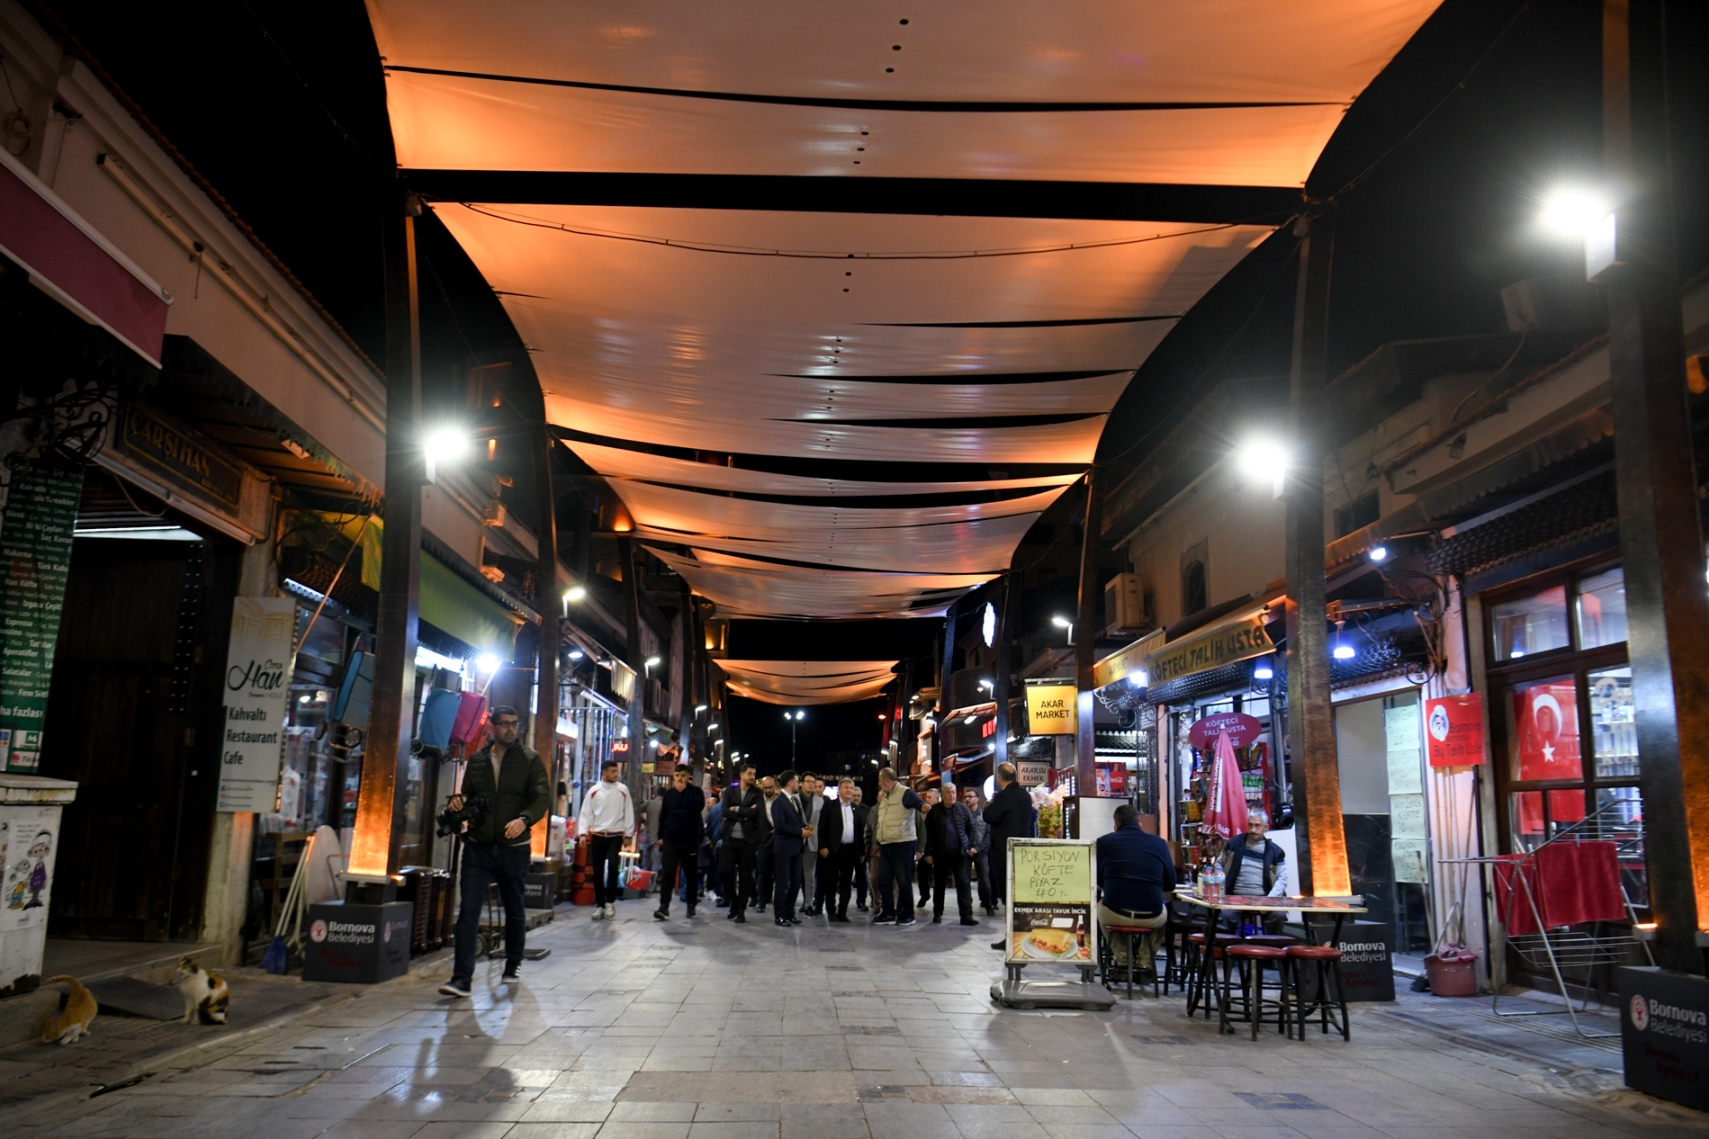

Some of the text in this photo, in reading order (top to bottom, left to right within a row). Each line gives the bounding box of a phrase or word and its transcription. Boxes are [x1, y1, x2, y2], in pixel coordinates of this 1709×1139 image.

[179, 443, 210, 478] HAN
[19, 483, 47, 493] Kahaltı
[26, 522, 42, 531] Biki
[5, 617, 34, 628] Espresso
[1150, 650, 1187, 683] KÖFTECİ
[1190, 639, 1223, 668] TALİH
[1228, 626, 1265, 655] USTA
[228, 660, 283, 691] Han
[0, 705, 11, 716] ha
[1041, 700, 1063, 709] AKAR
[229, 707, 267, 721] Kahvaltı
[1036, 710, 1070, 719] MARKET
[226, 729, 278, 743] Restaurant
[1203, 725, 1246, 737] TALİ USTA
[224, 751, 244, 765] Cafe
[1033, 863, 1075, 877] KÖFTE
[1030, 876, 1064, 889] PİYAZ
[1036, 888, 1057, 899] 40
[1071, 906, 1087, 915] İNCİK
[329, 921, 376, 934] Bornova
[328, 933, 375, 946] Belediyesi
[1339, 941, 1386, 952] Bornova
[1340, 952, 1387, 964] Belediyesi
[1648, 998, 1707, 1027] Bornova
[1649, 1016, 1708, 1044] Belediyesi
